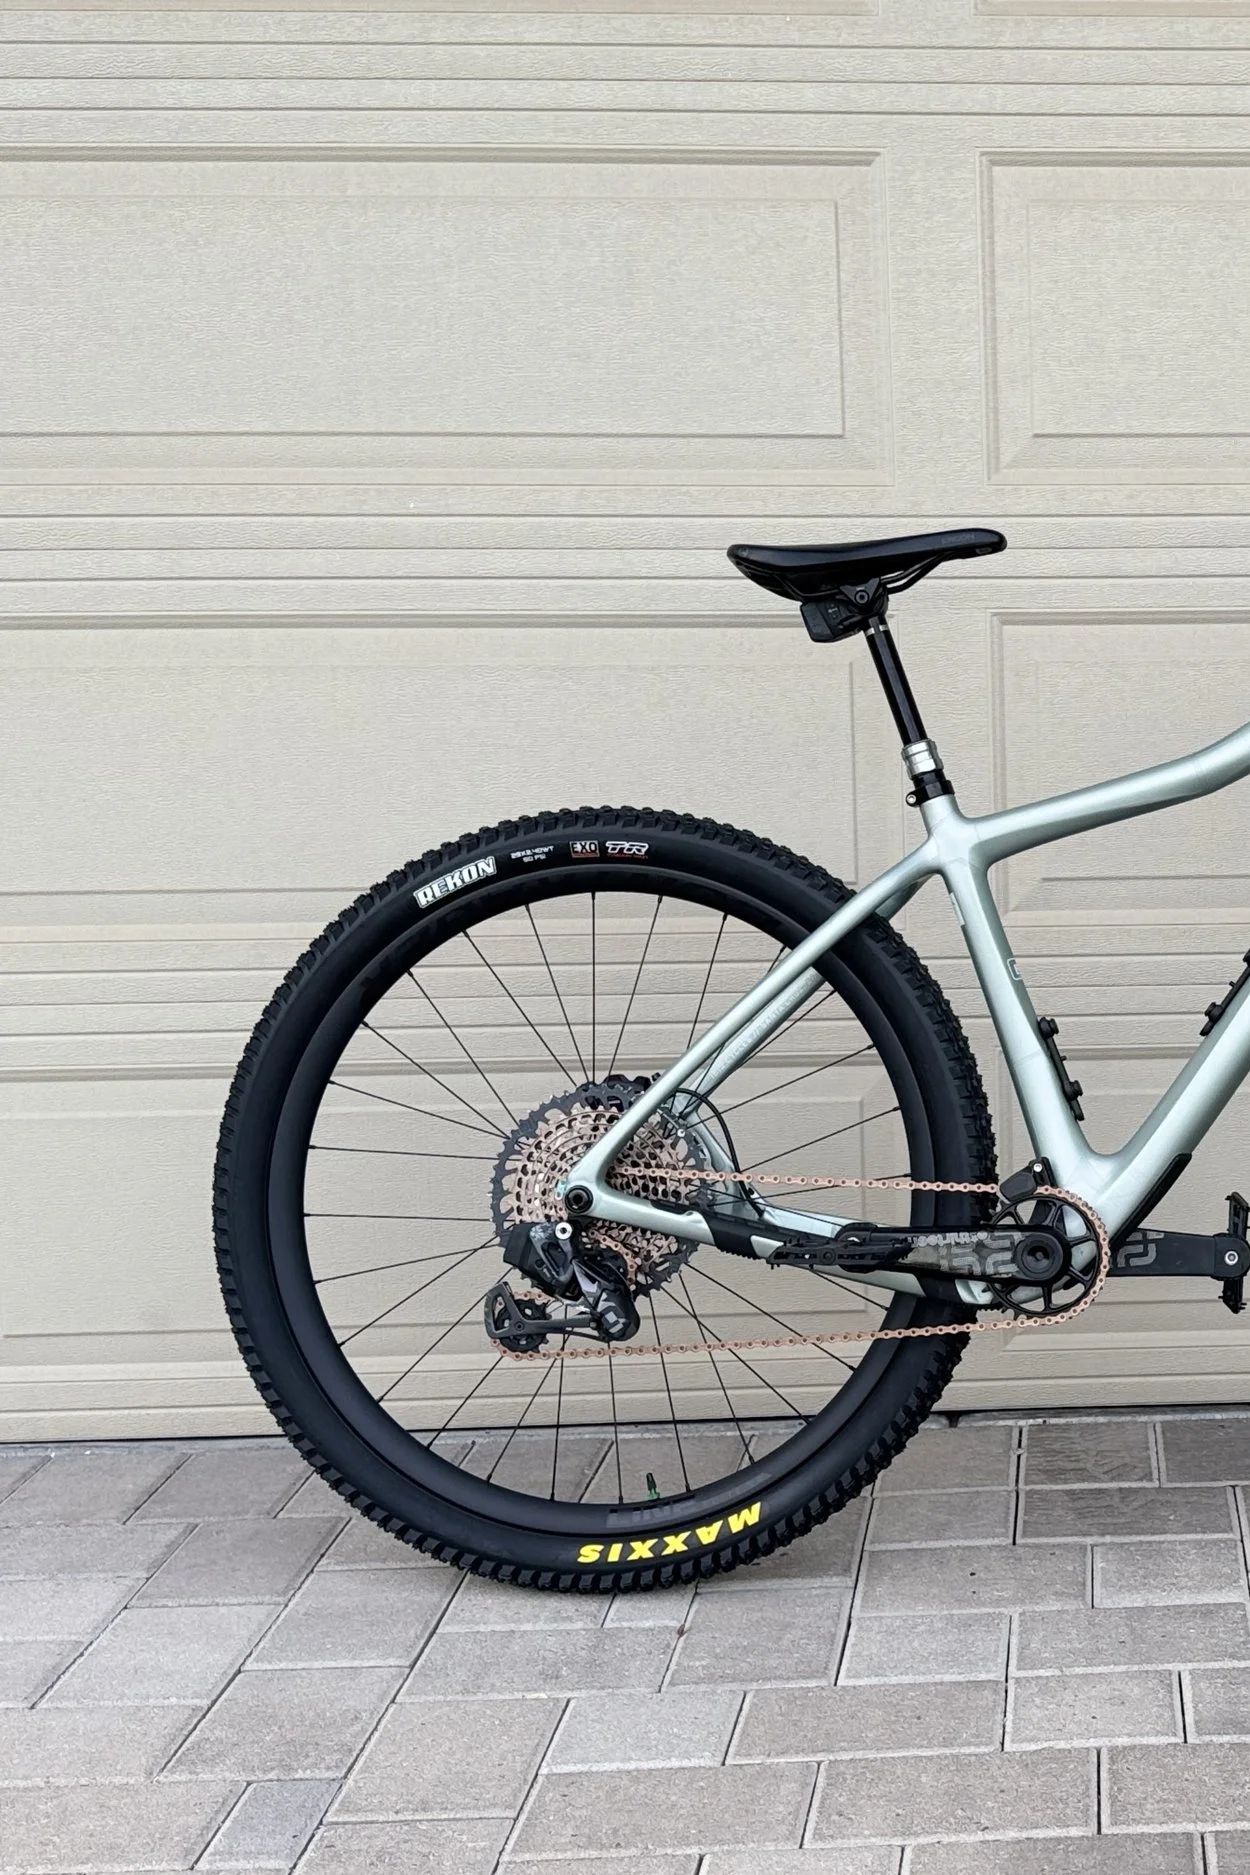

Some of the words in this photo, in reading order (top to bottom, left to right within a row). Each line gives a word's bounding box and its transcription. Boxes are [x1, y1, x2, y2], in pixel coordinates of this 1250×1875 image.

[570, 841, 598, 856] EXO
[605, 841, 649, 855] TR
[413, 856, 497, 908] REKON
[577, 1501, 762, 1563] MAXXIS
